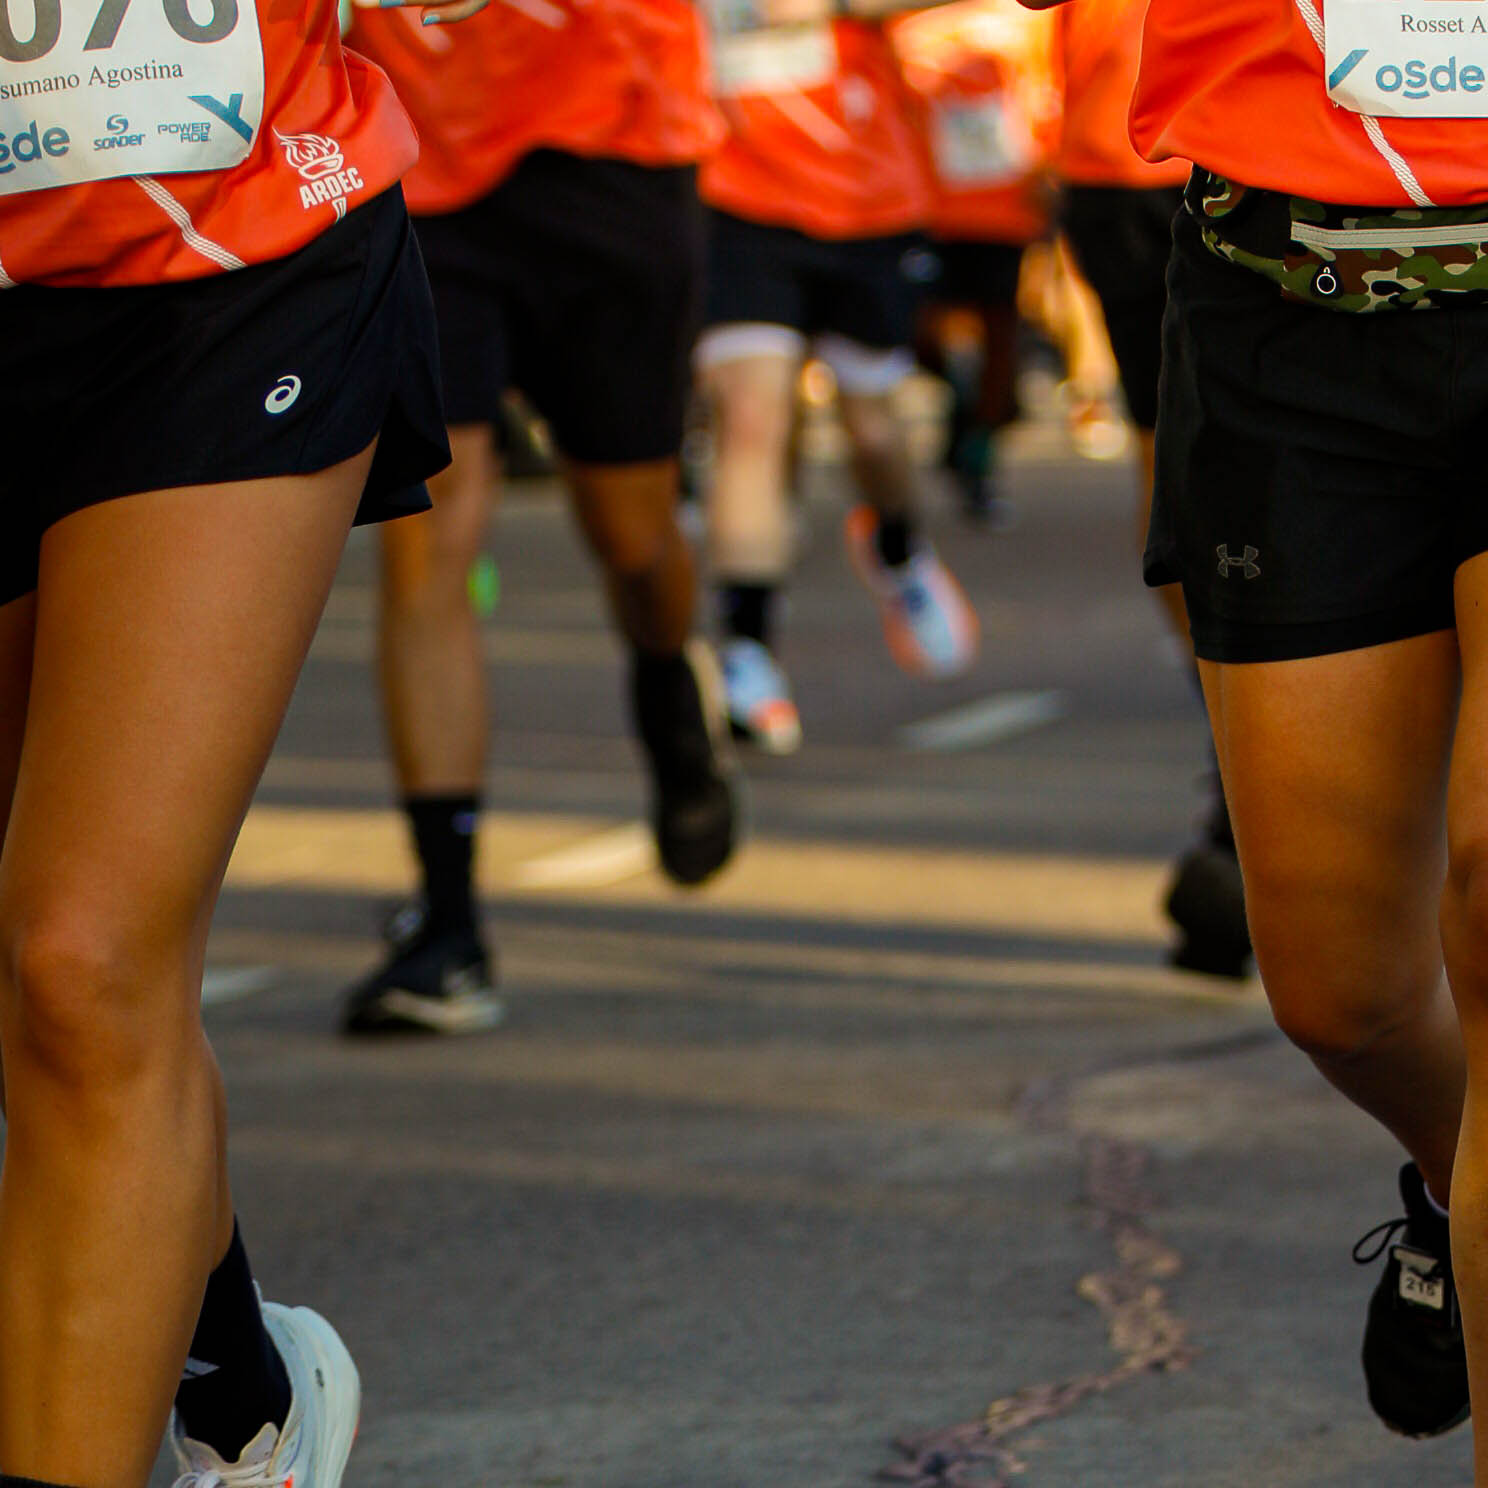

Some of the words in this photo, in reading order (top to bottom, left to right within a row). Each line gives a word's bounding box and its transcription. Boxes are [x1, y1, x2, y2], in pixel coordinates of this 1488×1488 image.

[1400, 14, 1464, 33] Rosset
[0, 72, 80, 100] sumano
[88, 59, 184, 88] Agostina
[1375, 56, 1485, 94] osde
[157, 122, 211, 134] POWER
[299, 166, 363, 209] ARDEC
